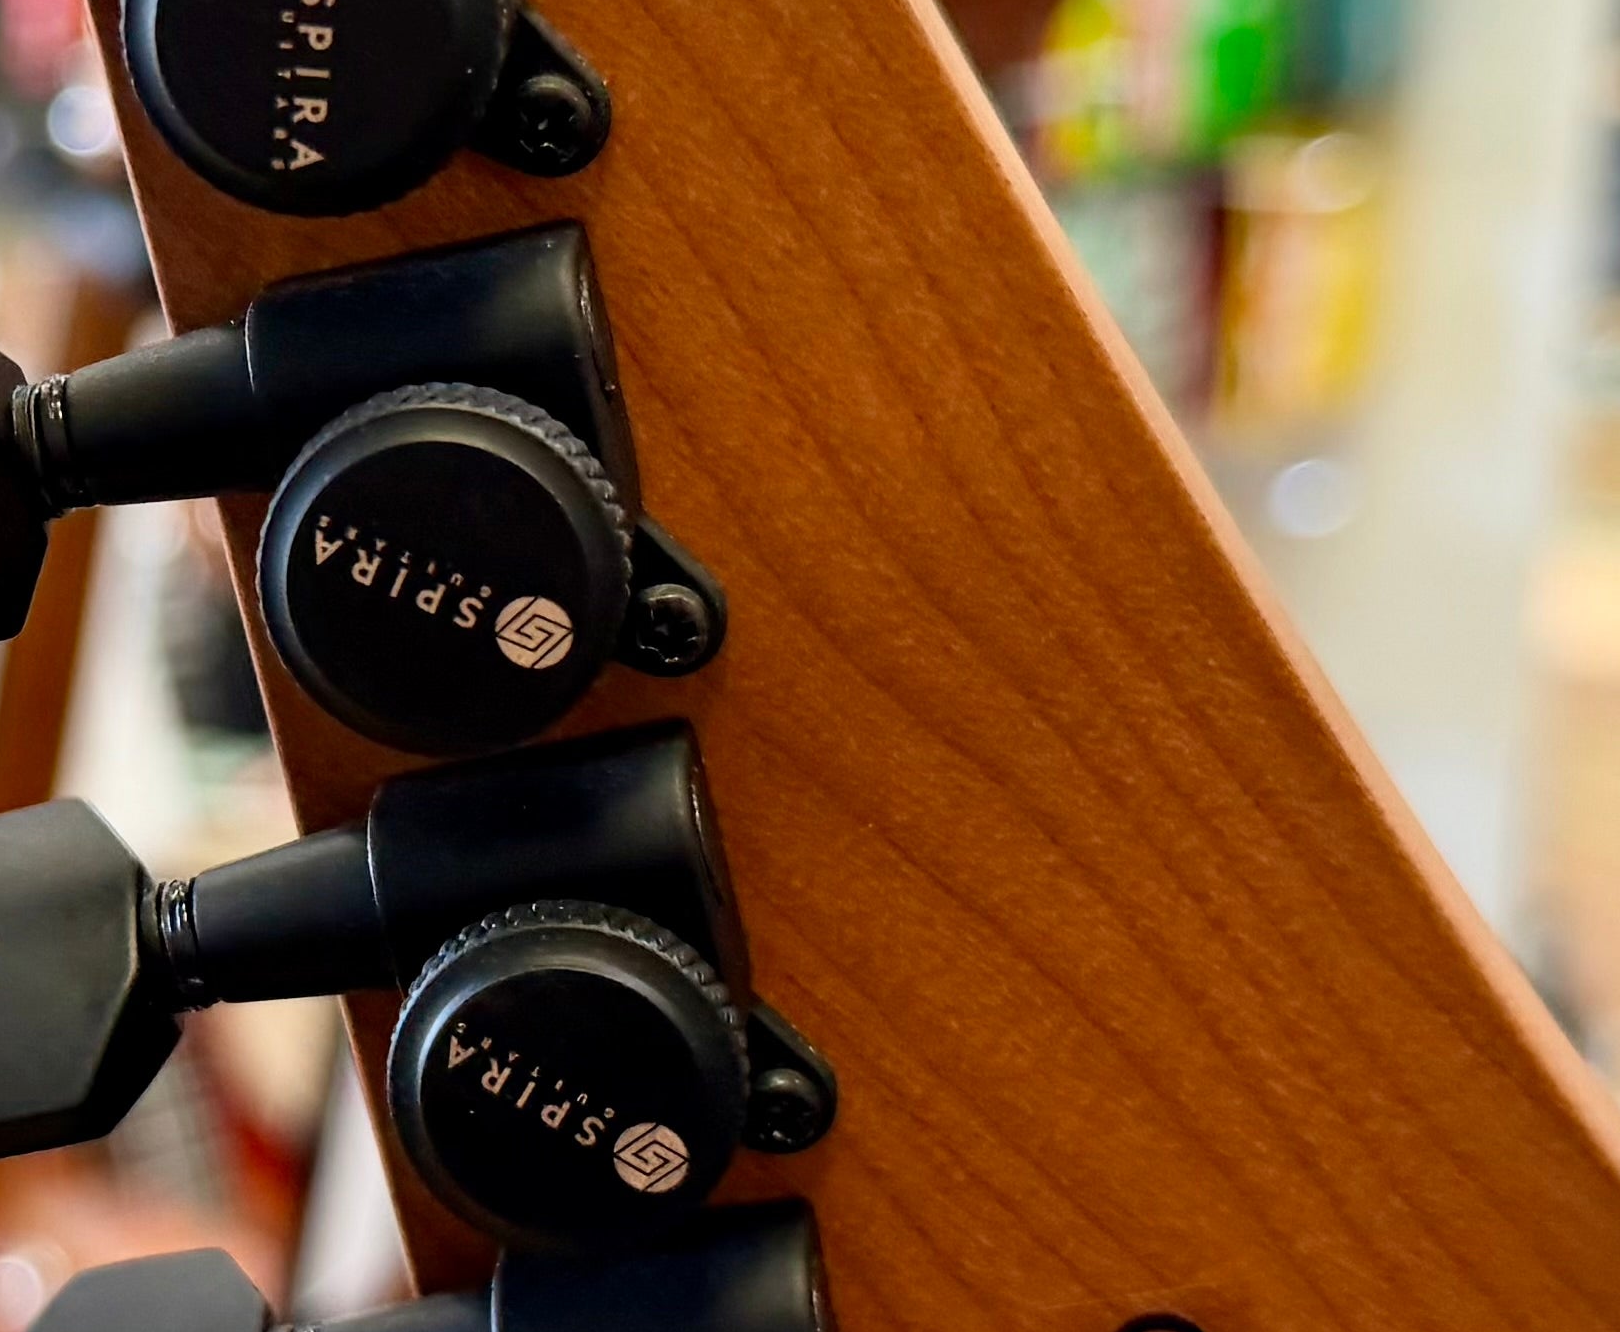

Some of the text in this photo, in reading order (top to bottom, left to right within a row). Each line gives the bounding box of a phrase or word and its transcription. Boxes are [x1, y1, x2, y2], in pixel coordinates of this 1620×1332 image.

[314, 527, 485, 629] SPIRA
[447, 1034, 606, 1147] SPIRA
[455, 1021, 615, 1119] GUITARS
